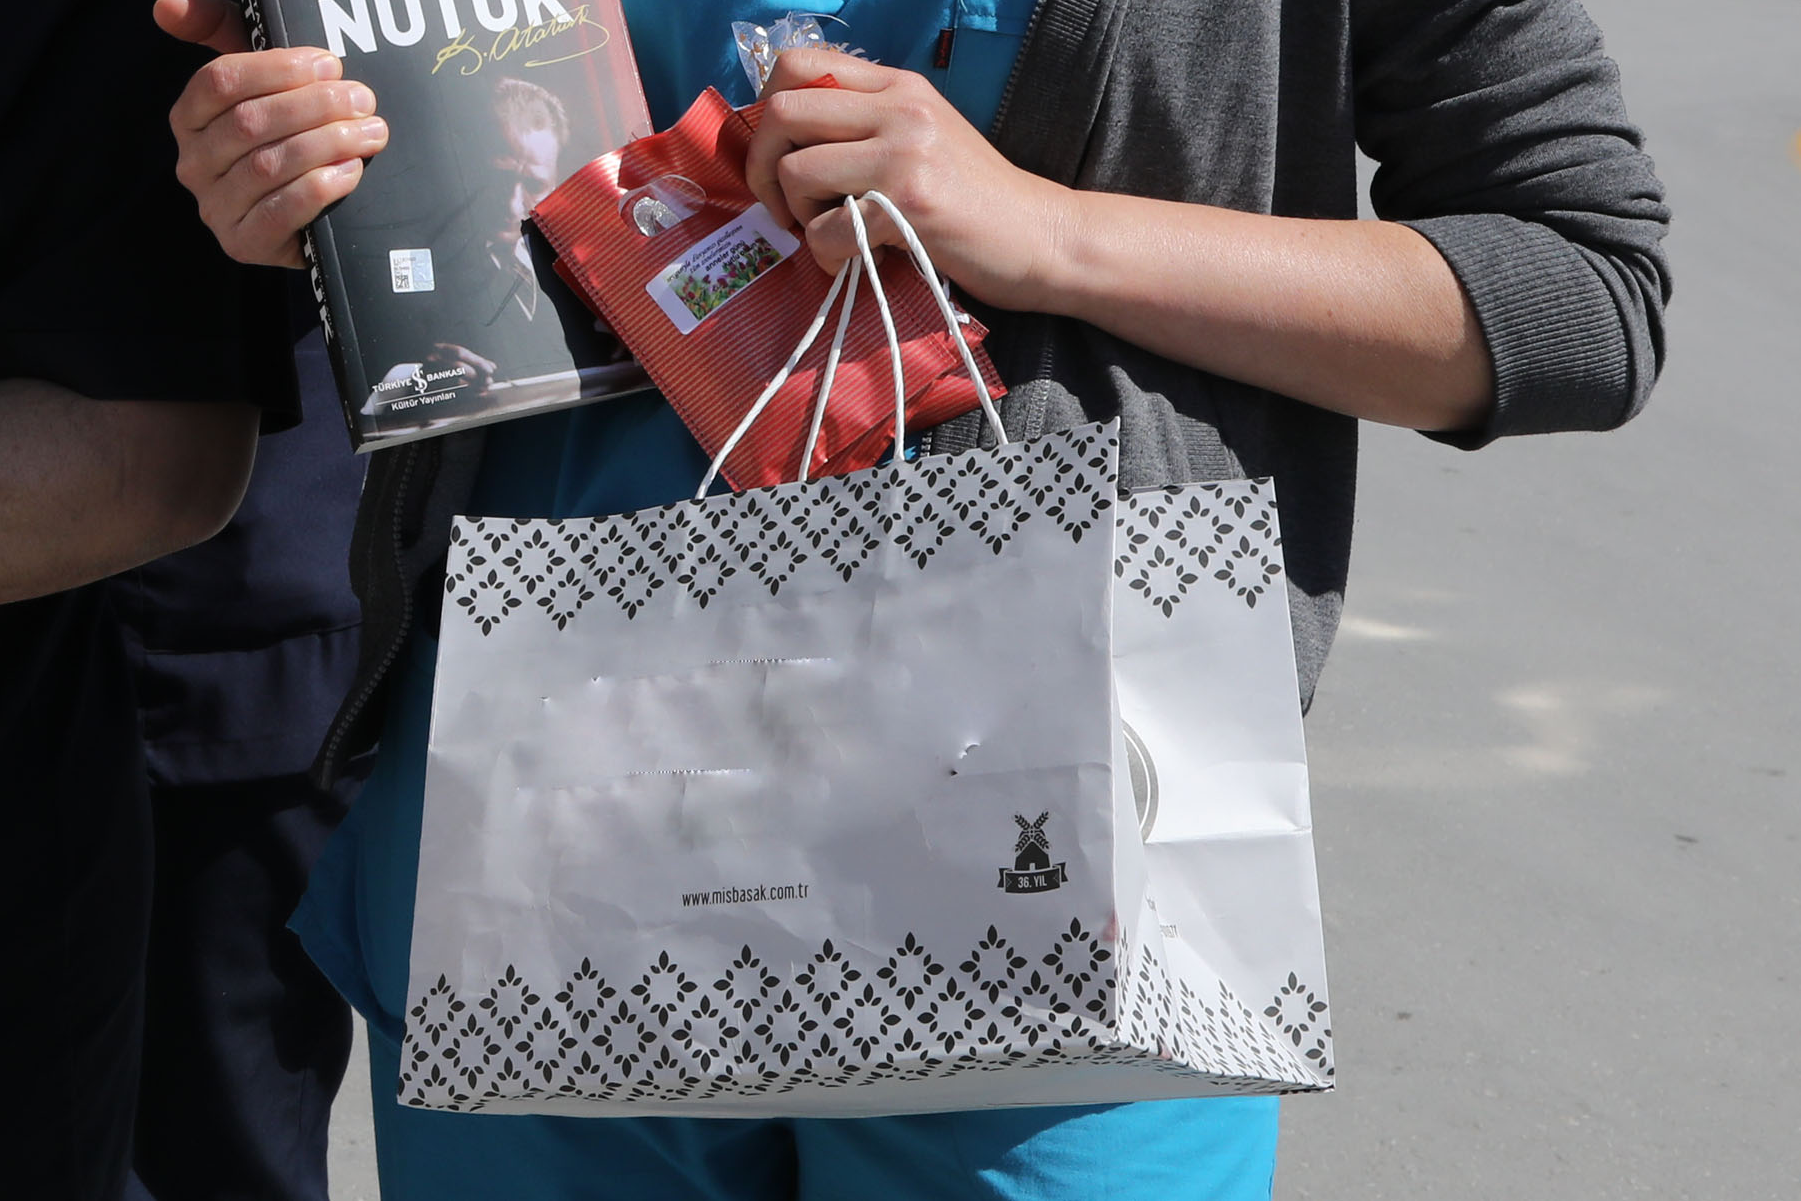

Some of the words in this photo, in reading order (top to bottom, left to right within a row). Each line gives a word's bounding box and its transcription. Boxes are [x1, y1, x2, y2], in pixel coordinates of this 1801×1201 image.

[372, 378, 413, 393] TÜRKİYE
[426, 367, 466, 382] BANKASI
[391, 399, 419, 411] Kültür
[419, 392, 456, 406] Yayınları
[1017, 876, 1032, 889] 36.
[1033, 874, 1048, 887] YIL
[681, 883, 810, 907] www.misbasak.com.tr
